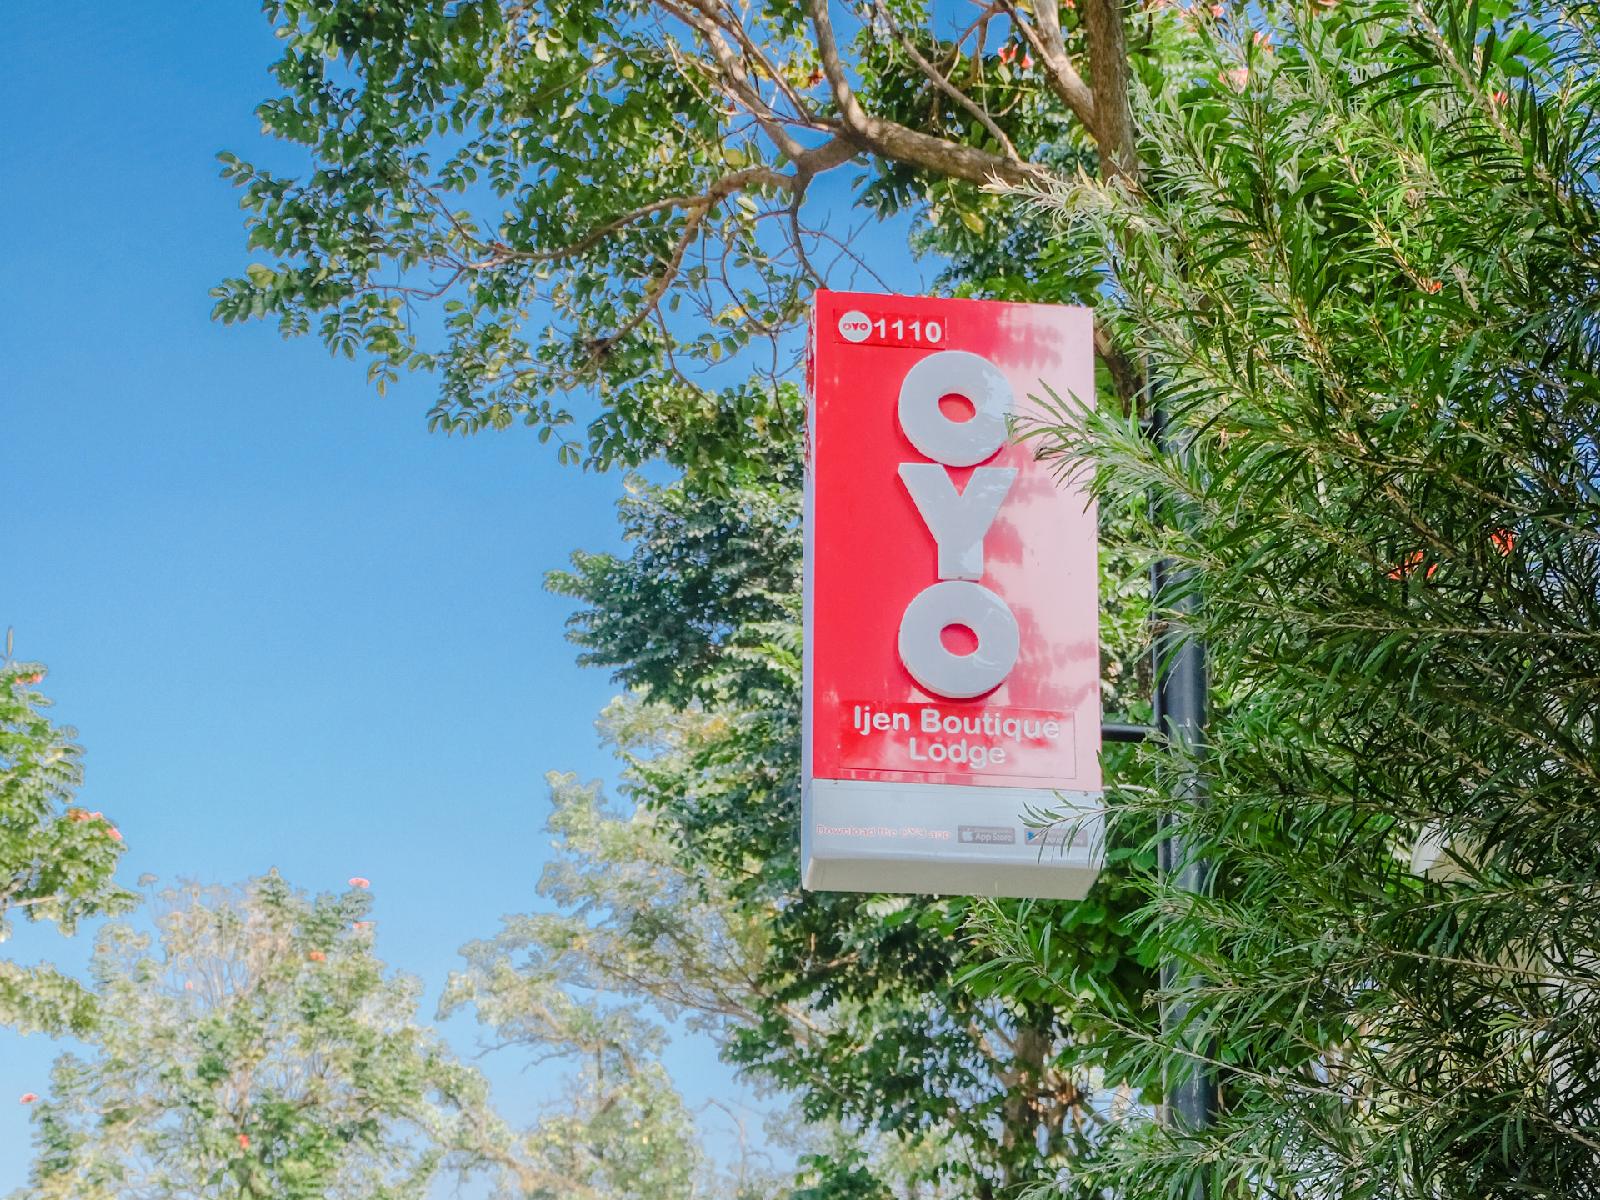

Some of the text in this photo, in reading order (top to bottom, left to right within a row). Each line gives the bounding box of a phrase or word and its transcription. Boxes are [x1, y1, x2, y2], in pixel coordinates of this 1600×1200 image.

[873, 318, 942, 343] 1110
[898, 350, 1020, 698] OYO
[853, 705, 1060, 741] Ijen Boutique
[910, 737, 1006, 769] Lodge
[975, 832, 992, 842] App
